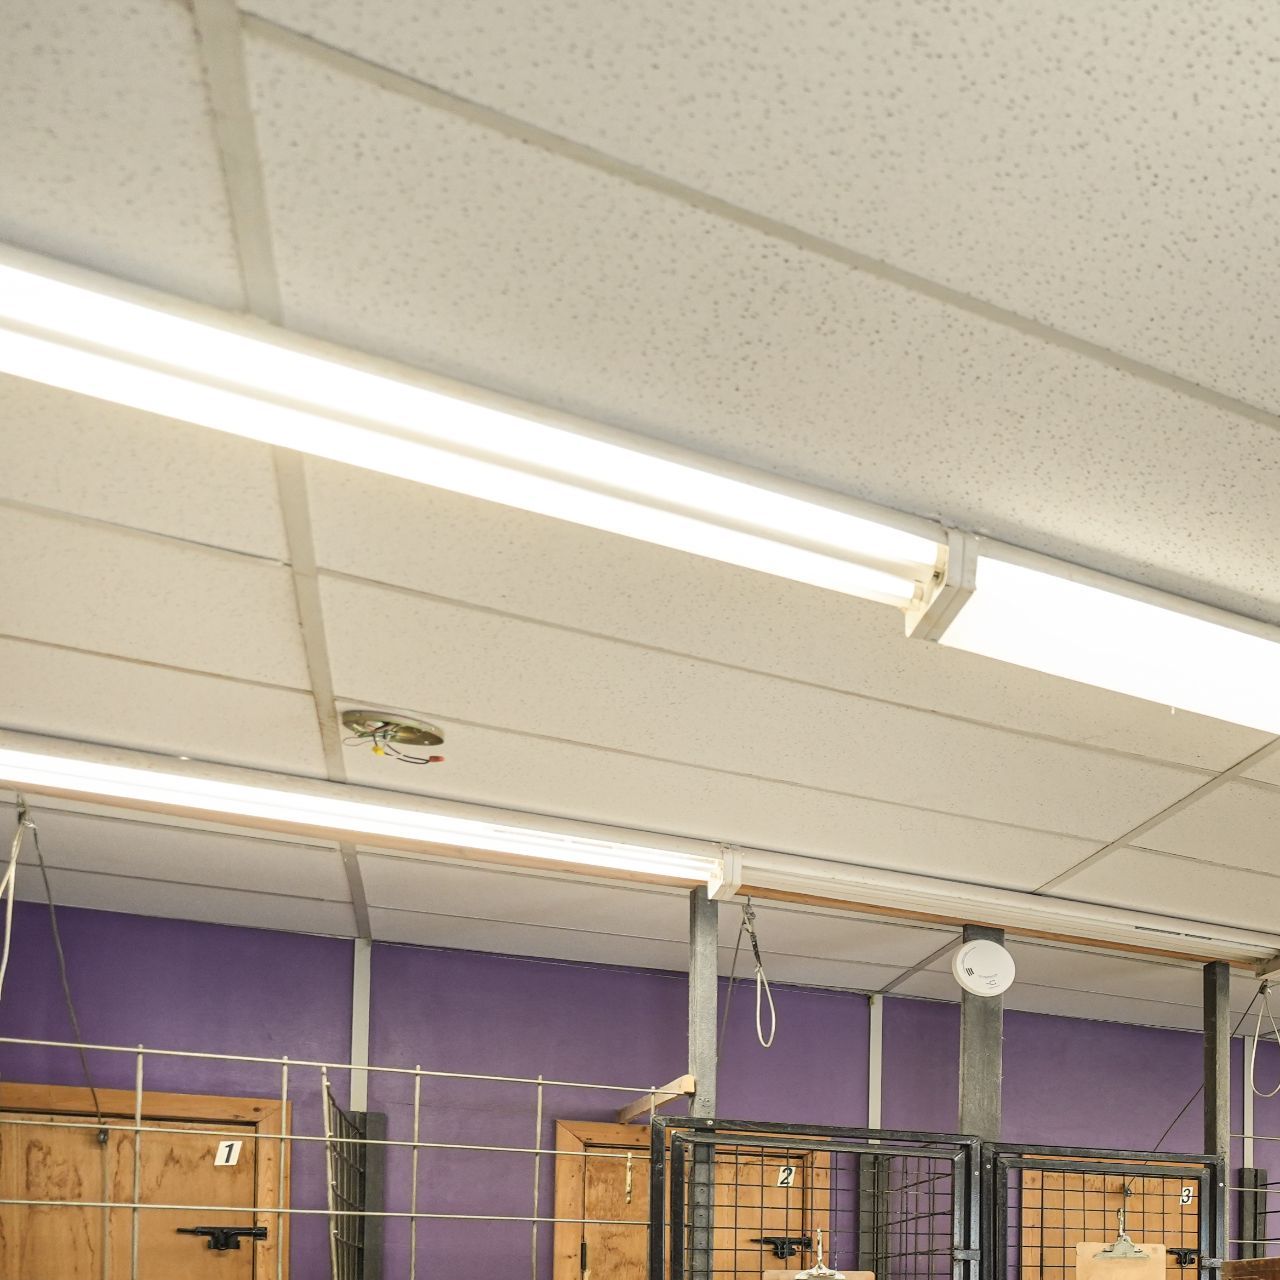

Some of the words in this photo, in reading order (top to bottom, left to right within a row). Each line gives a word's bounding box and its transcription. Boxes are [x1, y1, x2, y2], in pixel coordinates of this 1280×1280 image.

[225, 1143, 235, 1164] 1
[780, 1167, 793, 1185] 2
[1182, 1188, 1191, 1204] 3
